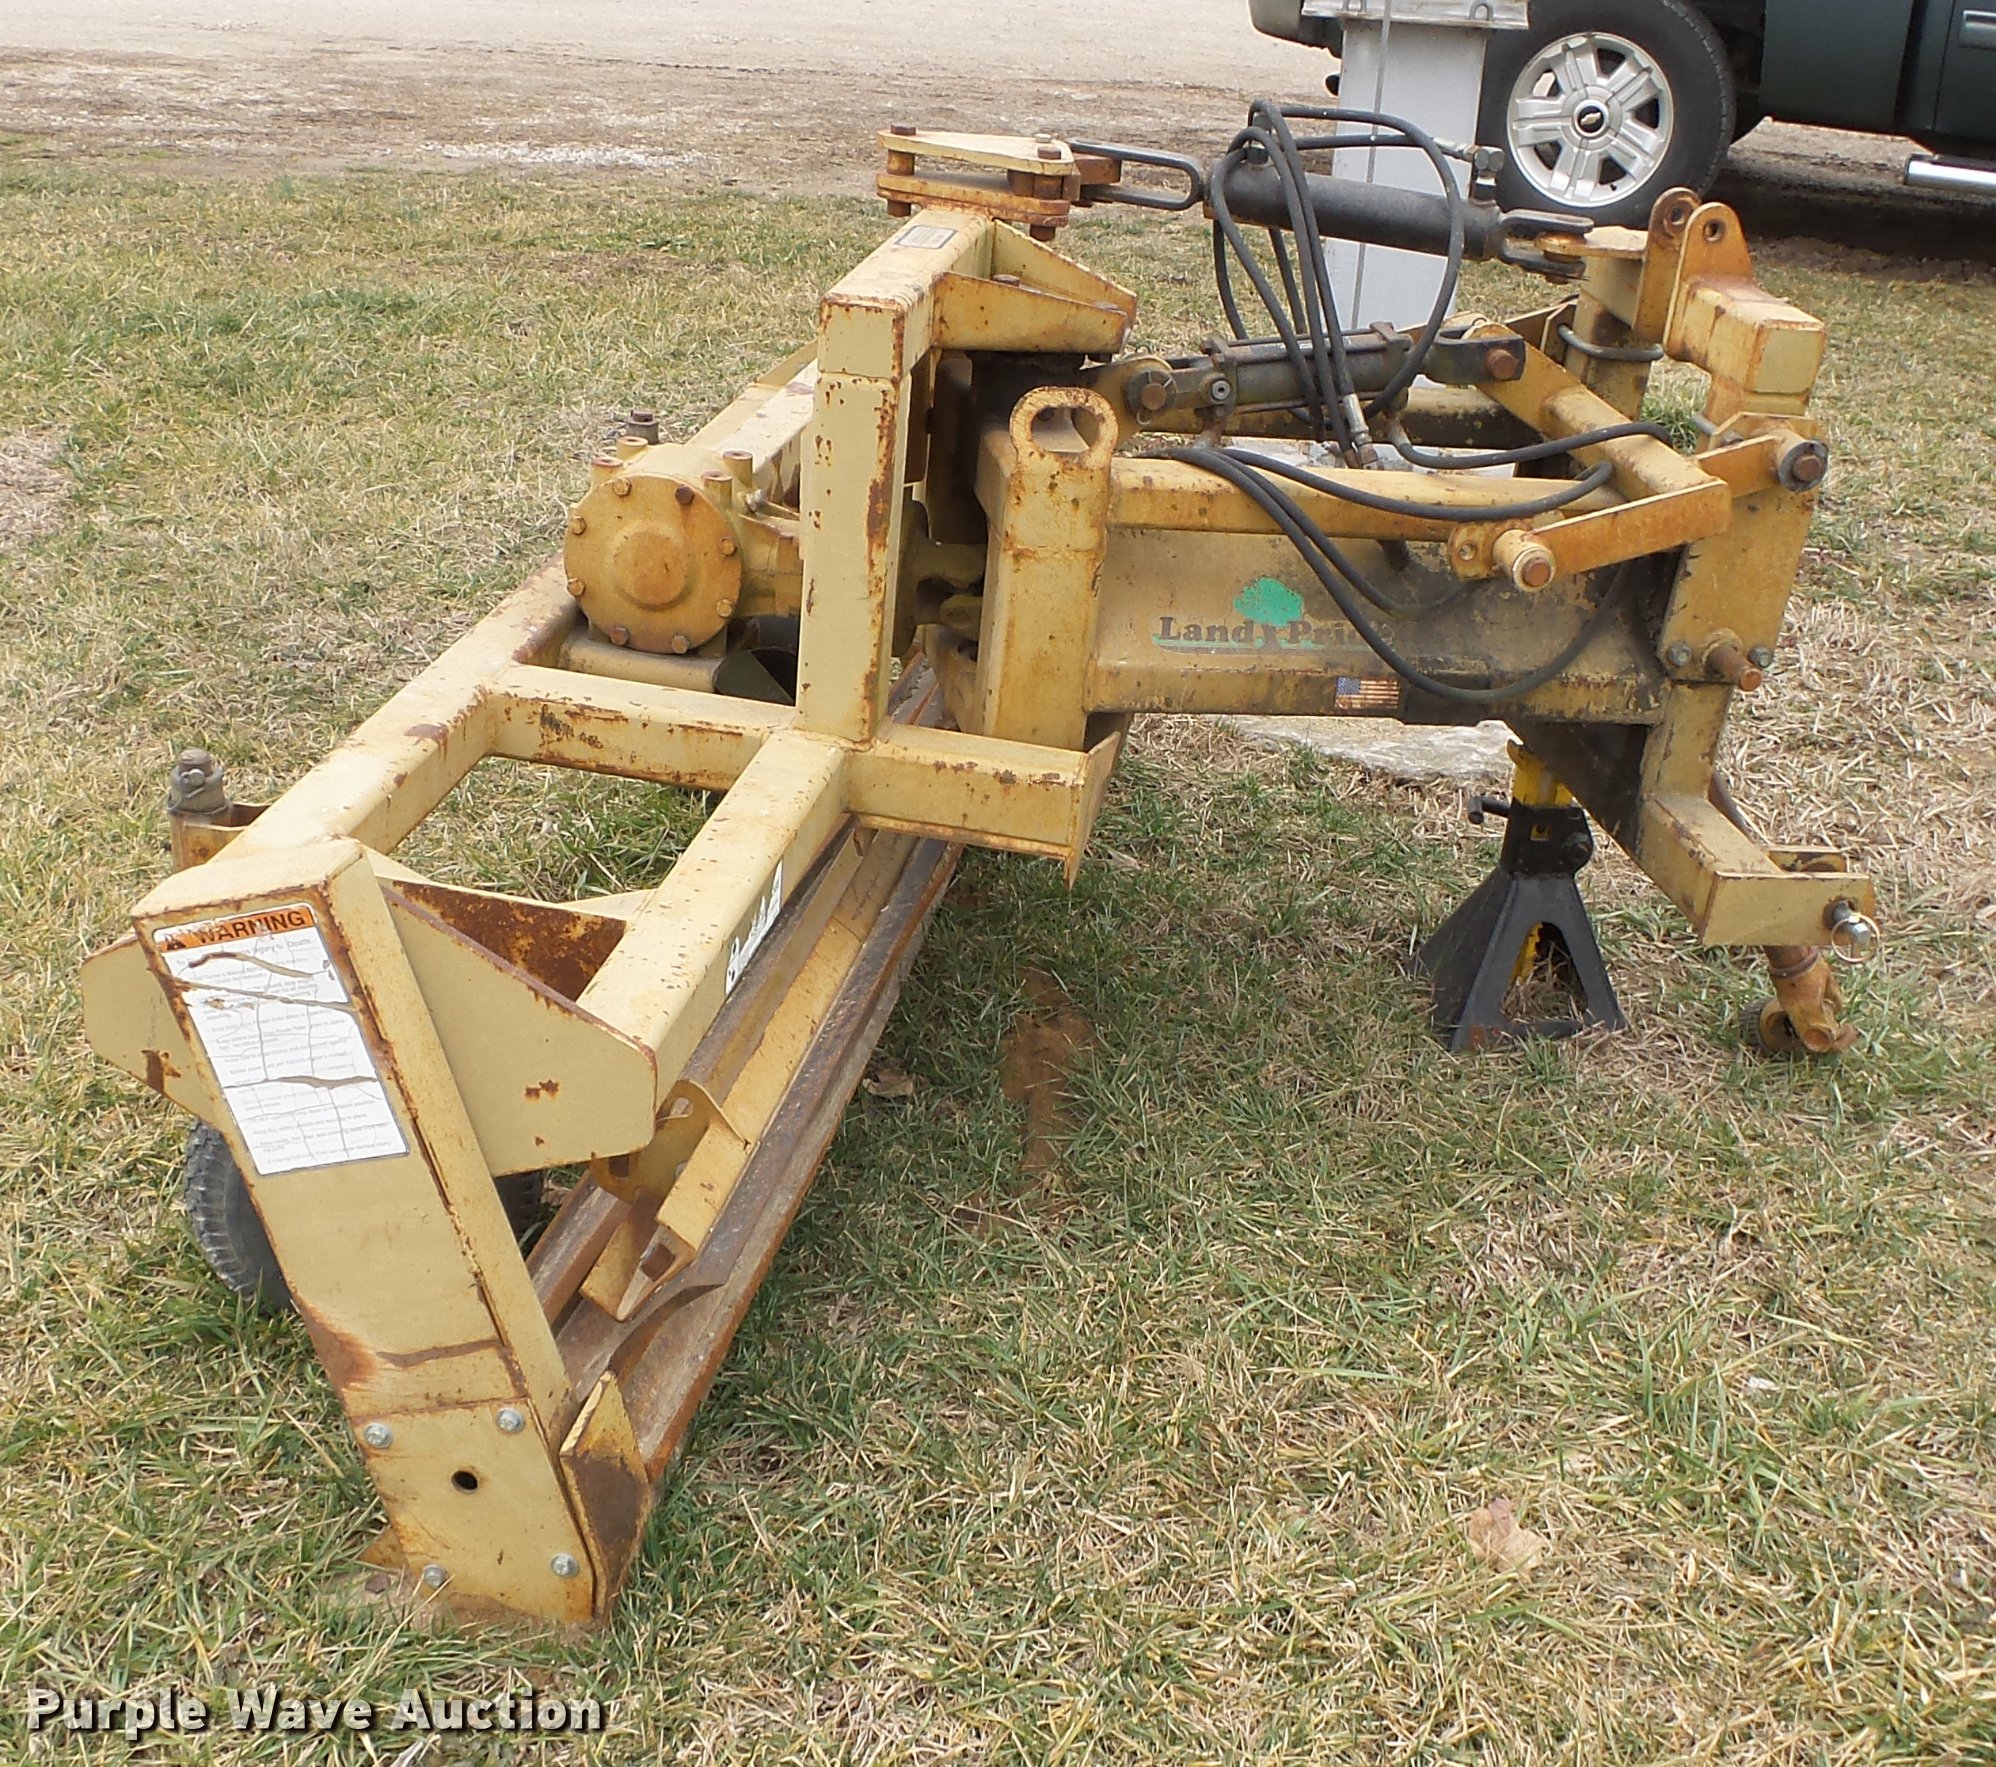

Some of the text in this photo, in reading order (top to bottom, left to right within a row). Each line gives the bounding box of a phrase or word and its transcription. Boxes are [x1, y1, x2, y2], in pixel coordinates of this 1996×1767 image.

[1158, 616, 1394, 647] Land Pri
[195, 911, 306, 944] WARNING
